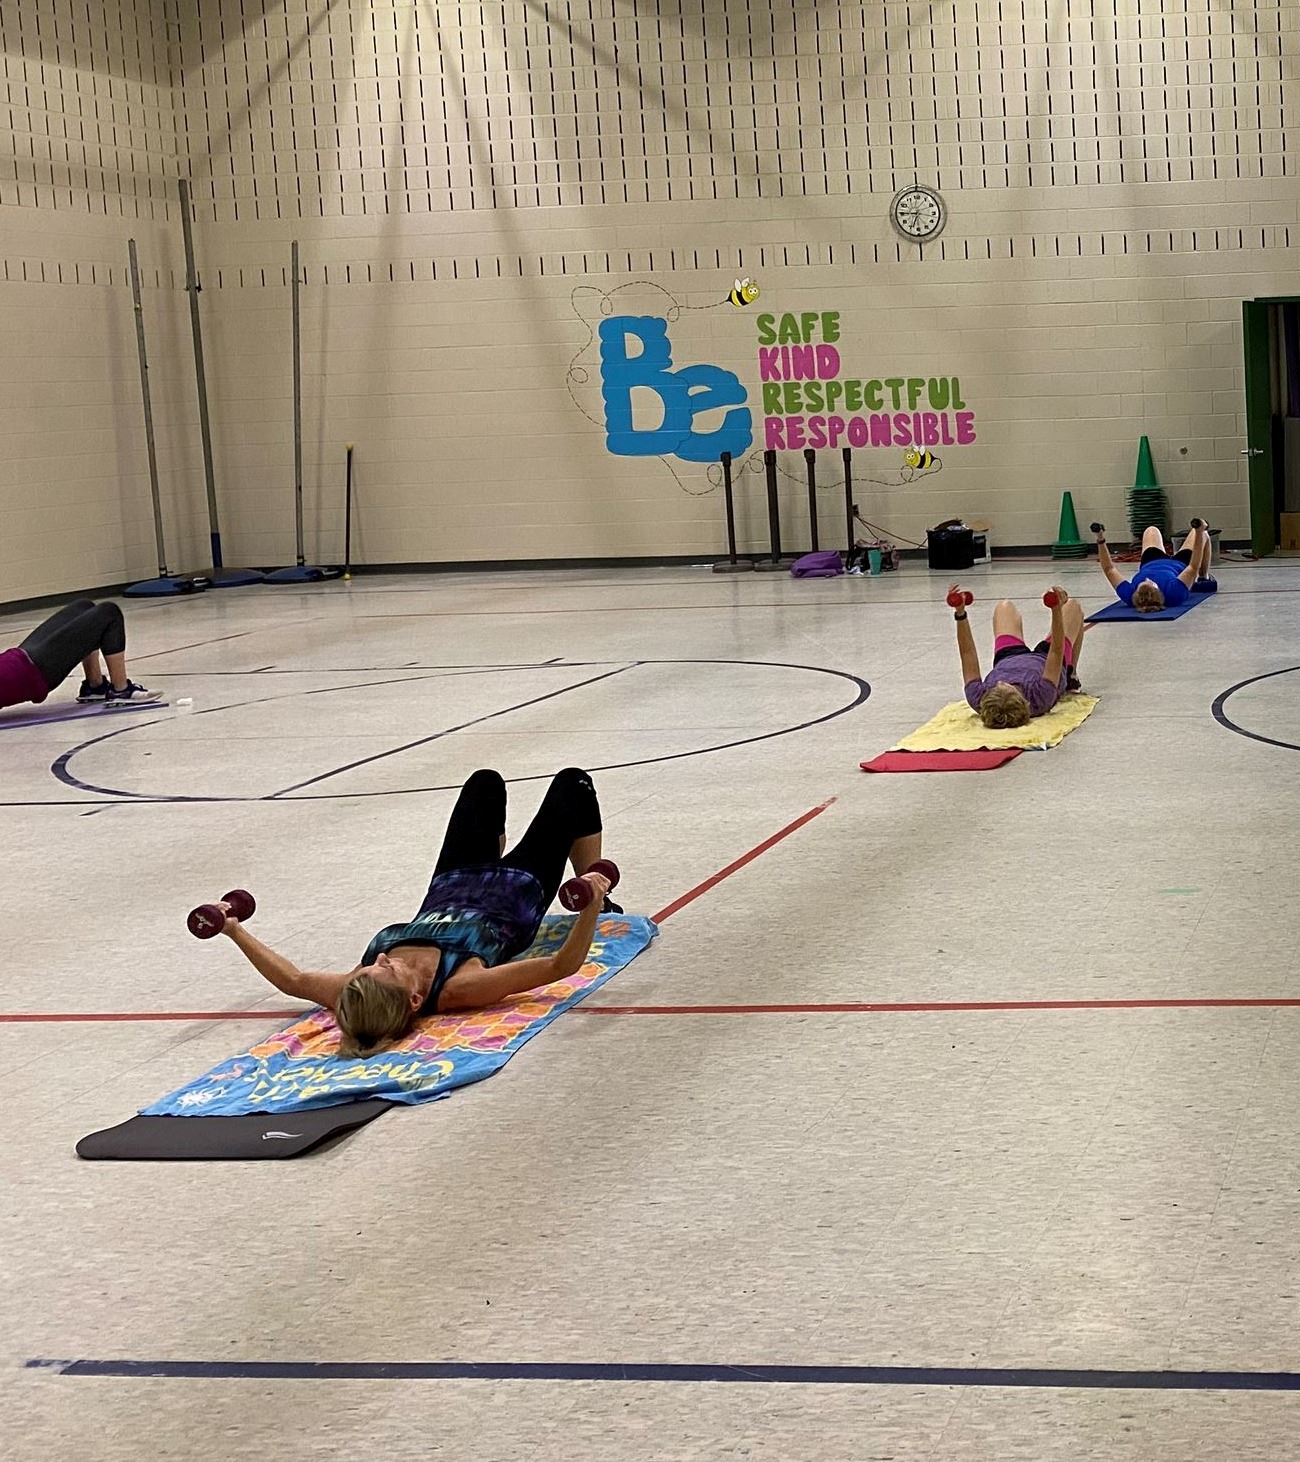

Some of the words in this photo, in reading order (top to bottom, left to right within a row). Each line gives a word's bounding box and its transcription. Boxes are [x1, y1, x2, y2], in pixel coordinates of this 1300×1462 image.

[756, 311, 841, 346] SAFE
[759, 344, 841, 382] KIND
[598, 315, 753, 463] Be
[762, 377, 966, 415] RESPECTFUL
[764, 411, 977, 451] RESPONSIBLE
